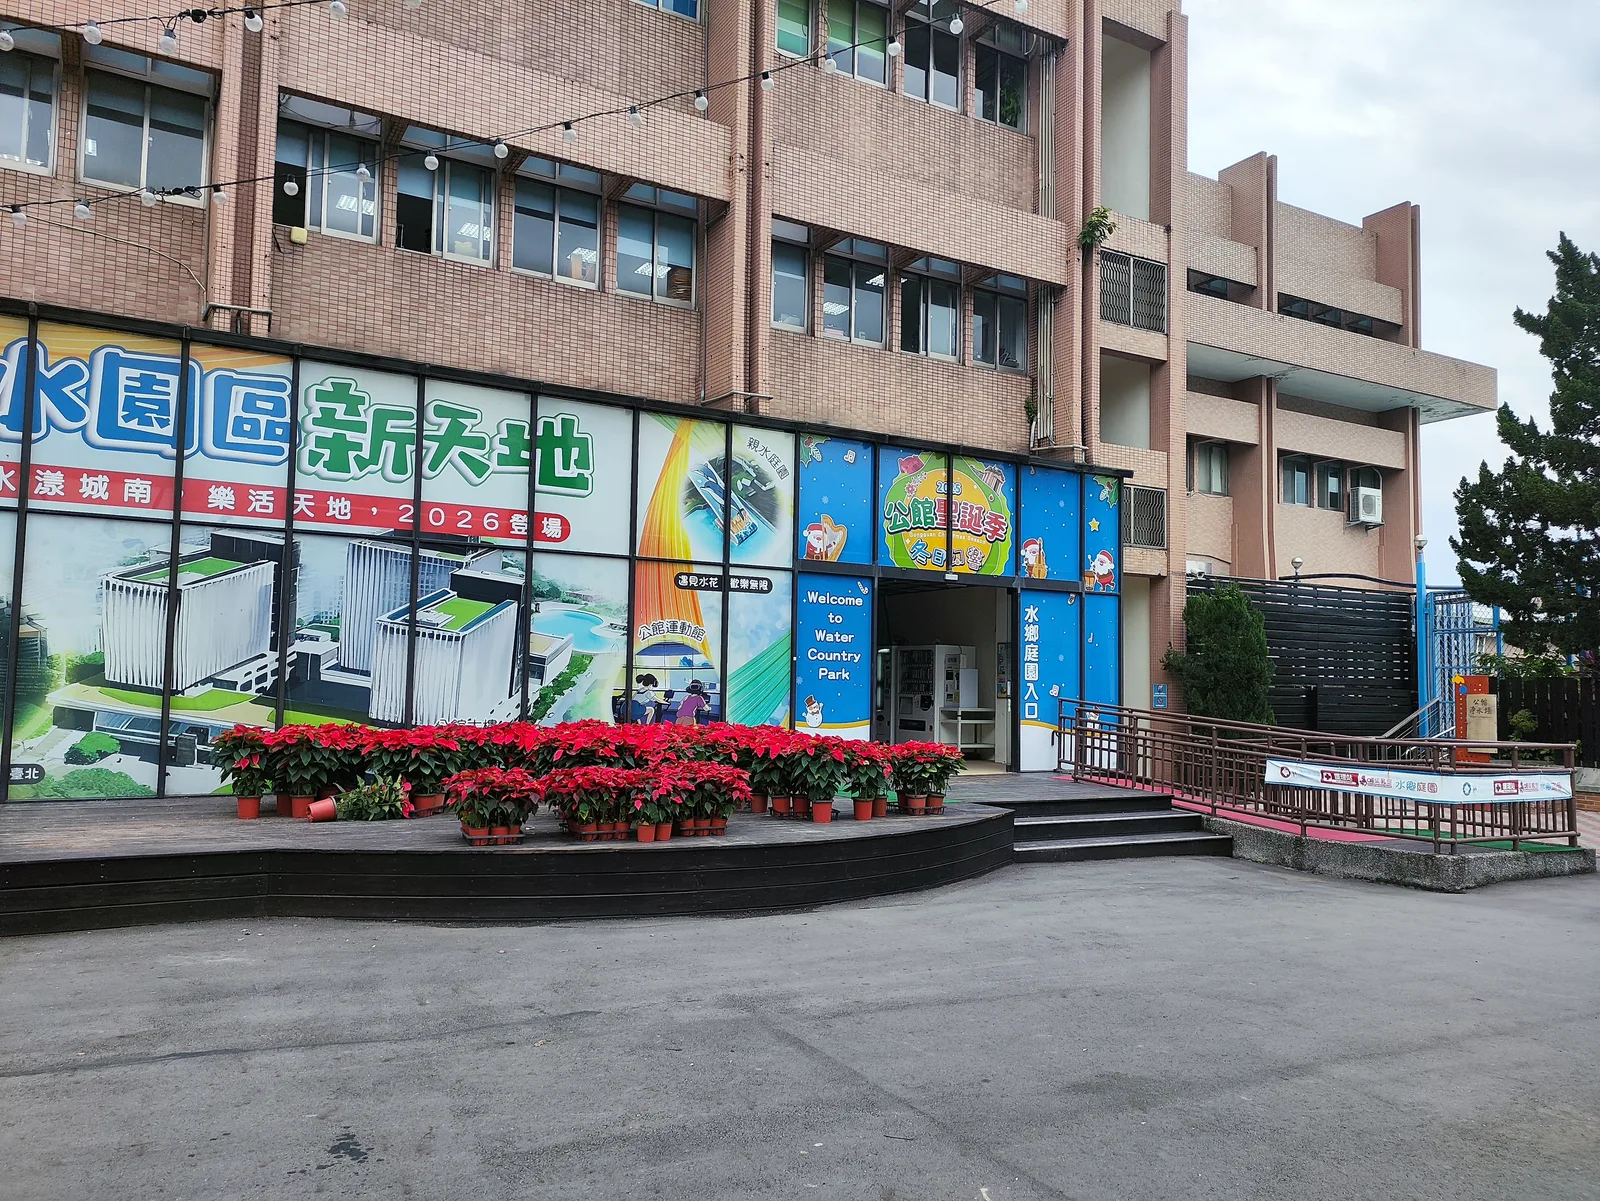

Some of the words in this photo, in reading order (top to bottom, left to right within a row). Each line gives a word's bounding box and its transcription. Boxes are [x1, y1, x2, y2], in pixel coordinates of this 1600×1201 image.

[746, 436, 790, 480] 親水庭園
[936, 480, 962, 495] 205
[885, 497, 1008, 542] 公館聖誕季
[678, 575, 719, 588] 遇見水花
[730, 578, 769, 591] 歡樂無限
[807, 590, 863, 606] Welcome
[828, 612, 843, 624] to
[638, 619, 706, 642] 公館運動館
[815, 629, 854, 643] Water
[807, 648, 861, 663] Country
[1024, 605, 1039, 719] 水鄉庭園入口
[818, 668, 850, 680] Park
[1396, 780, 1437, 793] 水鄉庭園
